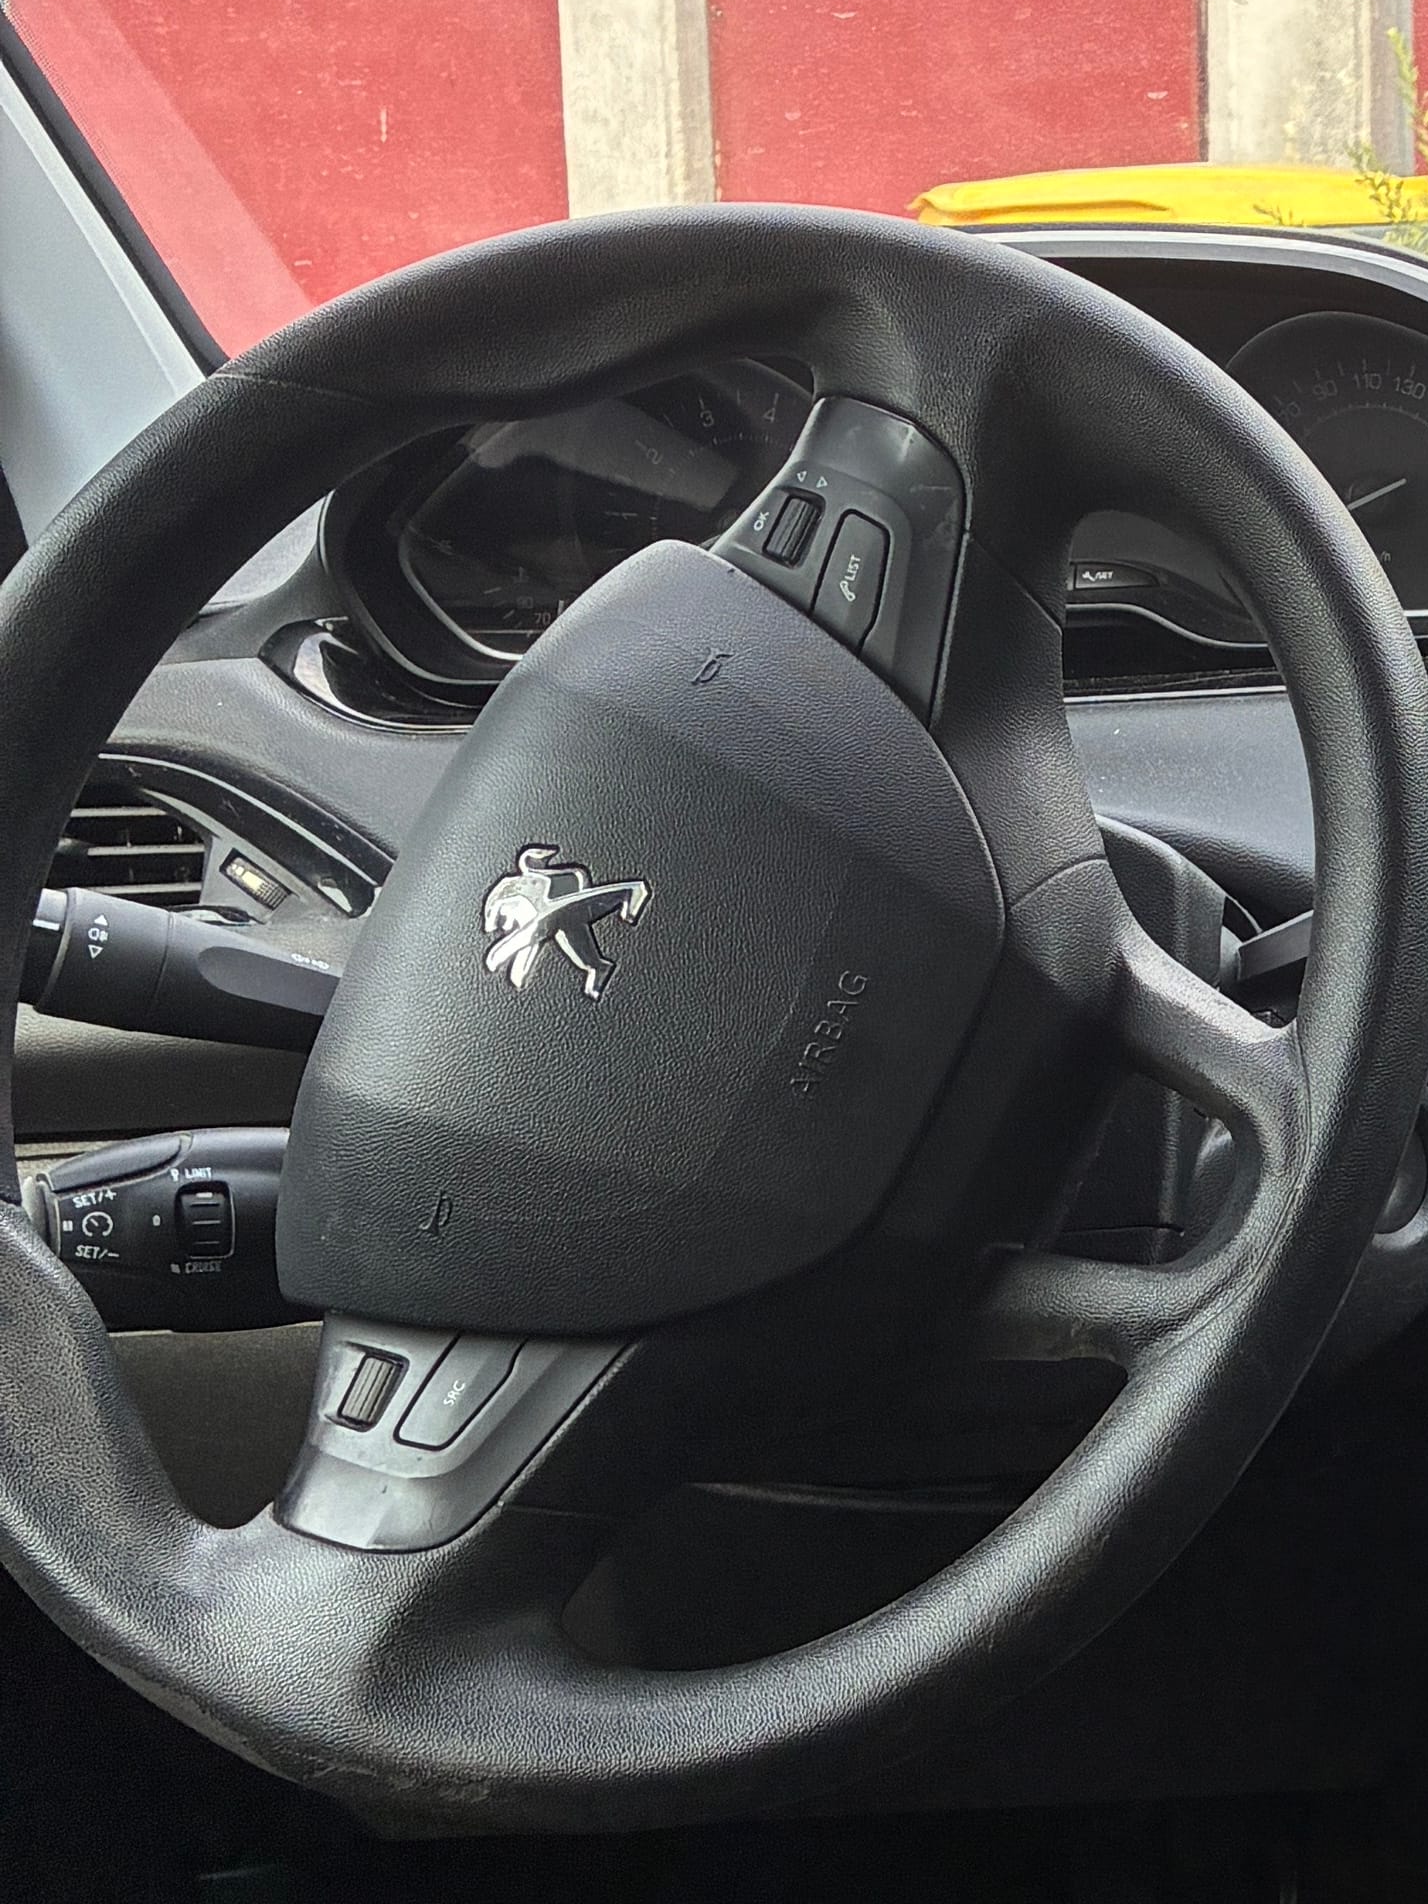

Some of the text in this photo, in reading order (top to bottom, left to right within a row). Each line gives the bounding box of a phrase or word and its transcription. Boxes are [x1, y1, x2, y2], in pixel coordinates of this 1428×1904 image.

[1353, 372, 1383, 391] 110
[1392, 375, 1427, 400] 130
[700, 409, 715, 428] 3
[761, 407, 777, 424] 4
[753, 511, 770, 531] OK
[844, 554, 861, 582] LIST
[443, 1379, 467, 1408] SRC
